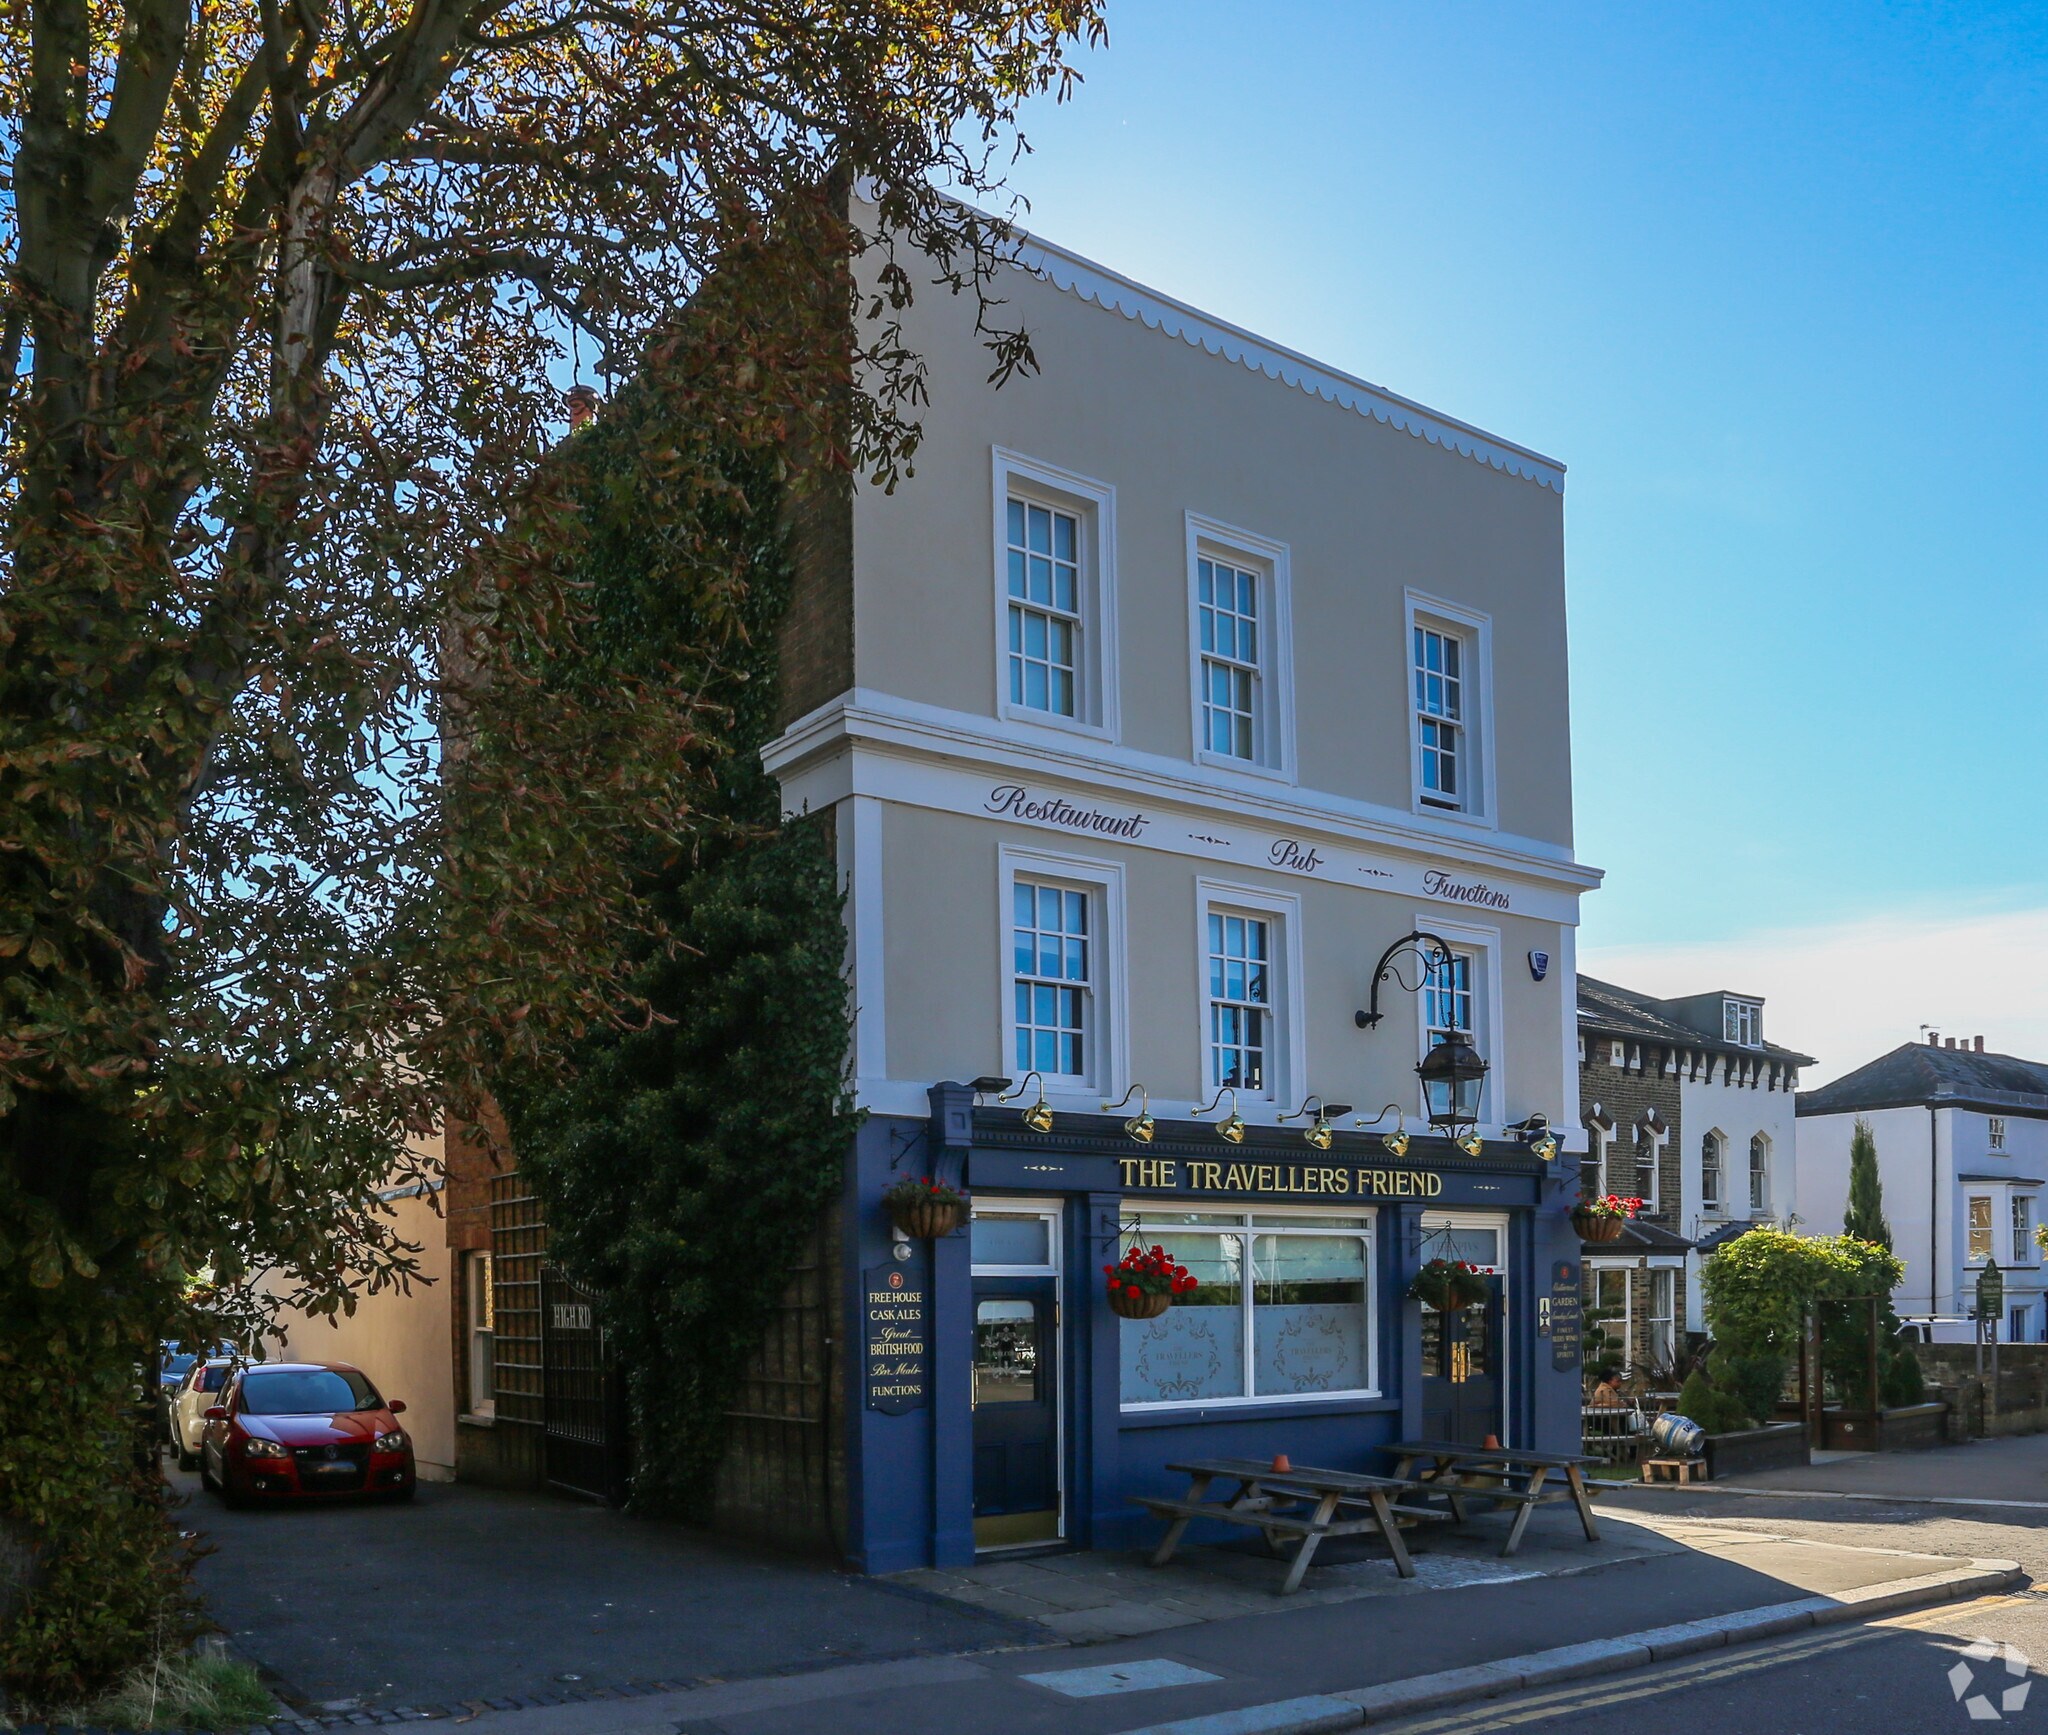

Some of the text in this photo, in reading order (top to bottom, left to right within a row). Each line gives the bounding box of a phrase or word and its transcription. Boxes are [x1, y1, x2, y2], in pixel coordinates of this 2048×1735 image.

[984, 785, 1510, 909] Restaurant Pub Functions
[1119, 1159, 1442, 1197] THE TRAVELLERS FRIEND
[869, 1292, 922, 1303] FREE HOUSE
[1552, 1297, 1578, 1306] GARDEN
[554, 1305, 591, 1328] HIGH RD
[870, 1309, 921, 1320] CASK ALES
[880, 1327, 912, 1343] Great
[870, 1343, 923, 1356] BRITISH FOOD
[870, 1362, 922, 1376] Bar Meals
[872, 1385, 922, 1397] FUNCTIONS
